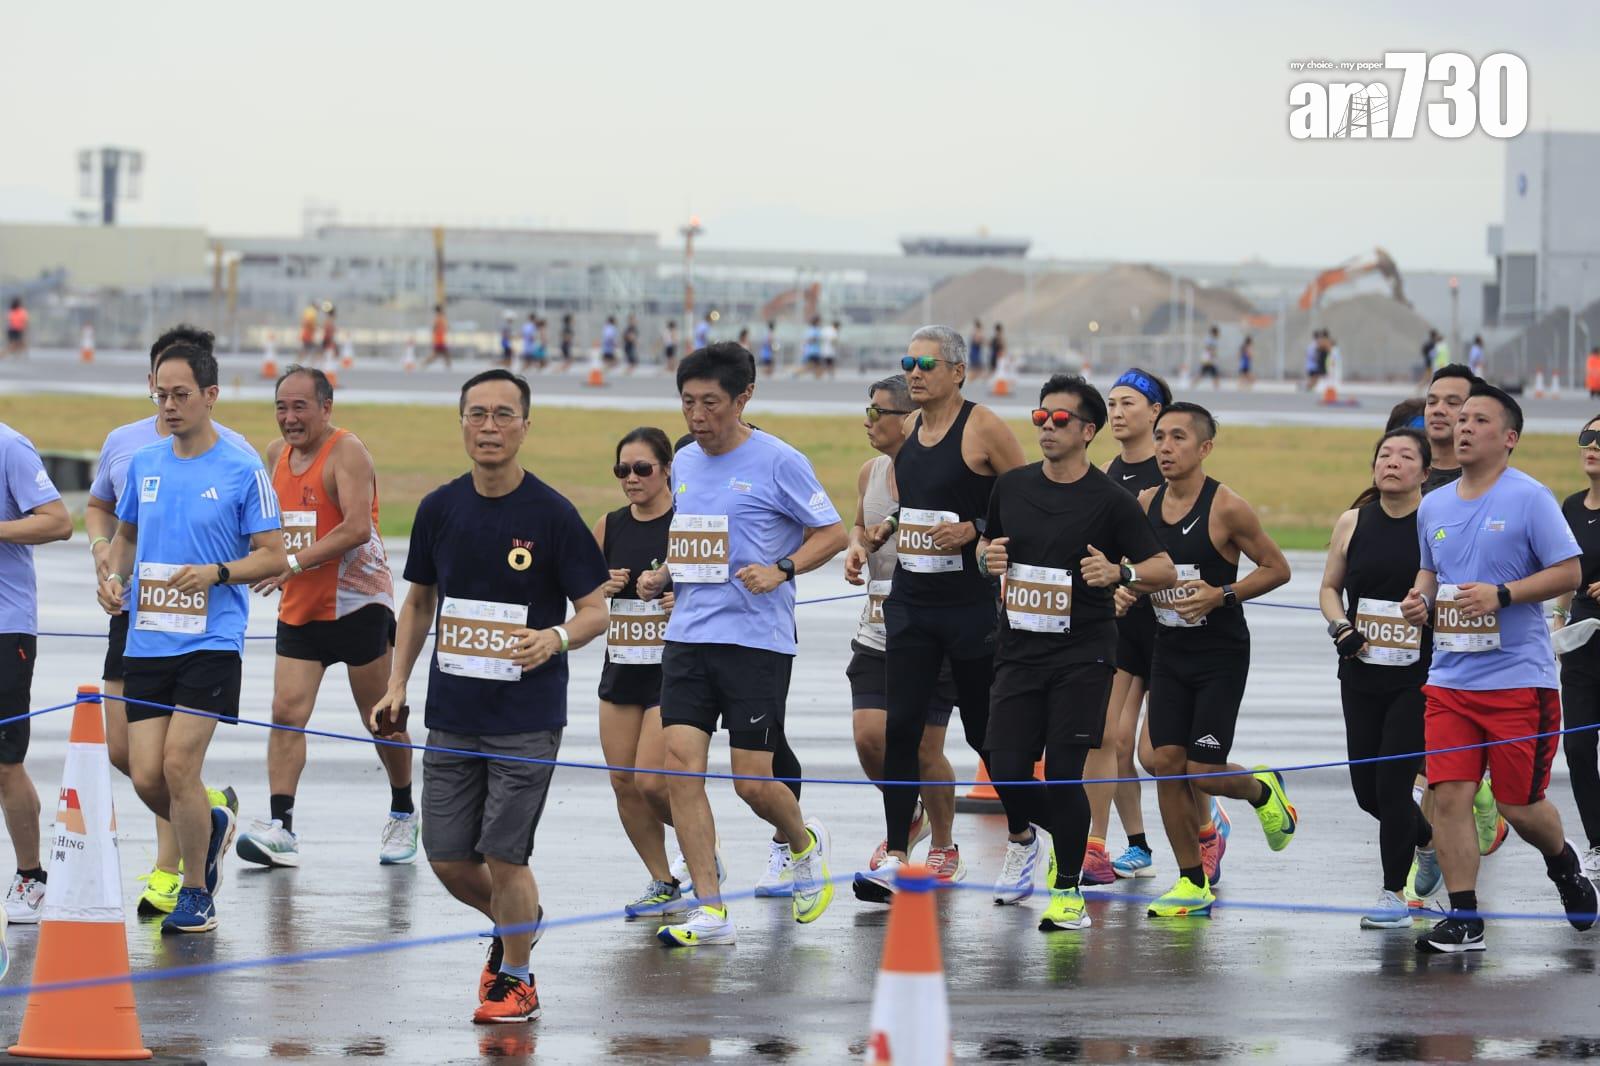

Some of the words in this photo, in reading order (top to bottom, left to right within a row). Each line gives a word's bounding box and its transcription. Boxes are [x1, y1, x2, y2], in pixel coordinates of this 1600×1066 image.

[669, 537, 726, 558] H0104
[899, 528, 954, 551] H09
[140, 585, 205, 609] H0256
[1006, 584, 1069, 611] H0019
[442, 623, 520, 653] H2354
[609, 620, 668, 641] H1988
[1357, 619, 1418, 644] H0652
